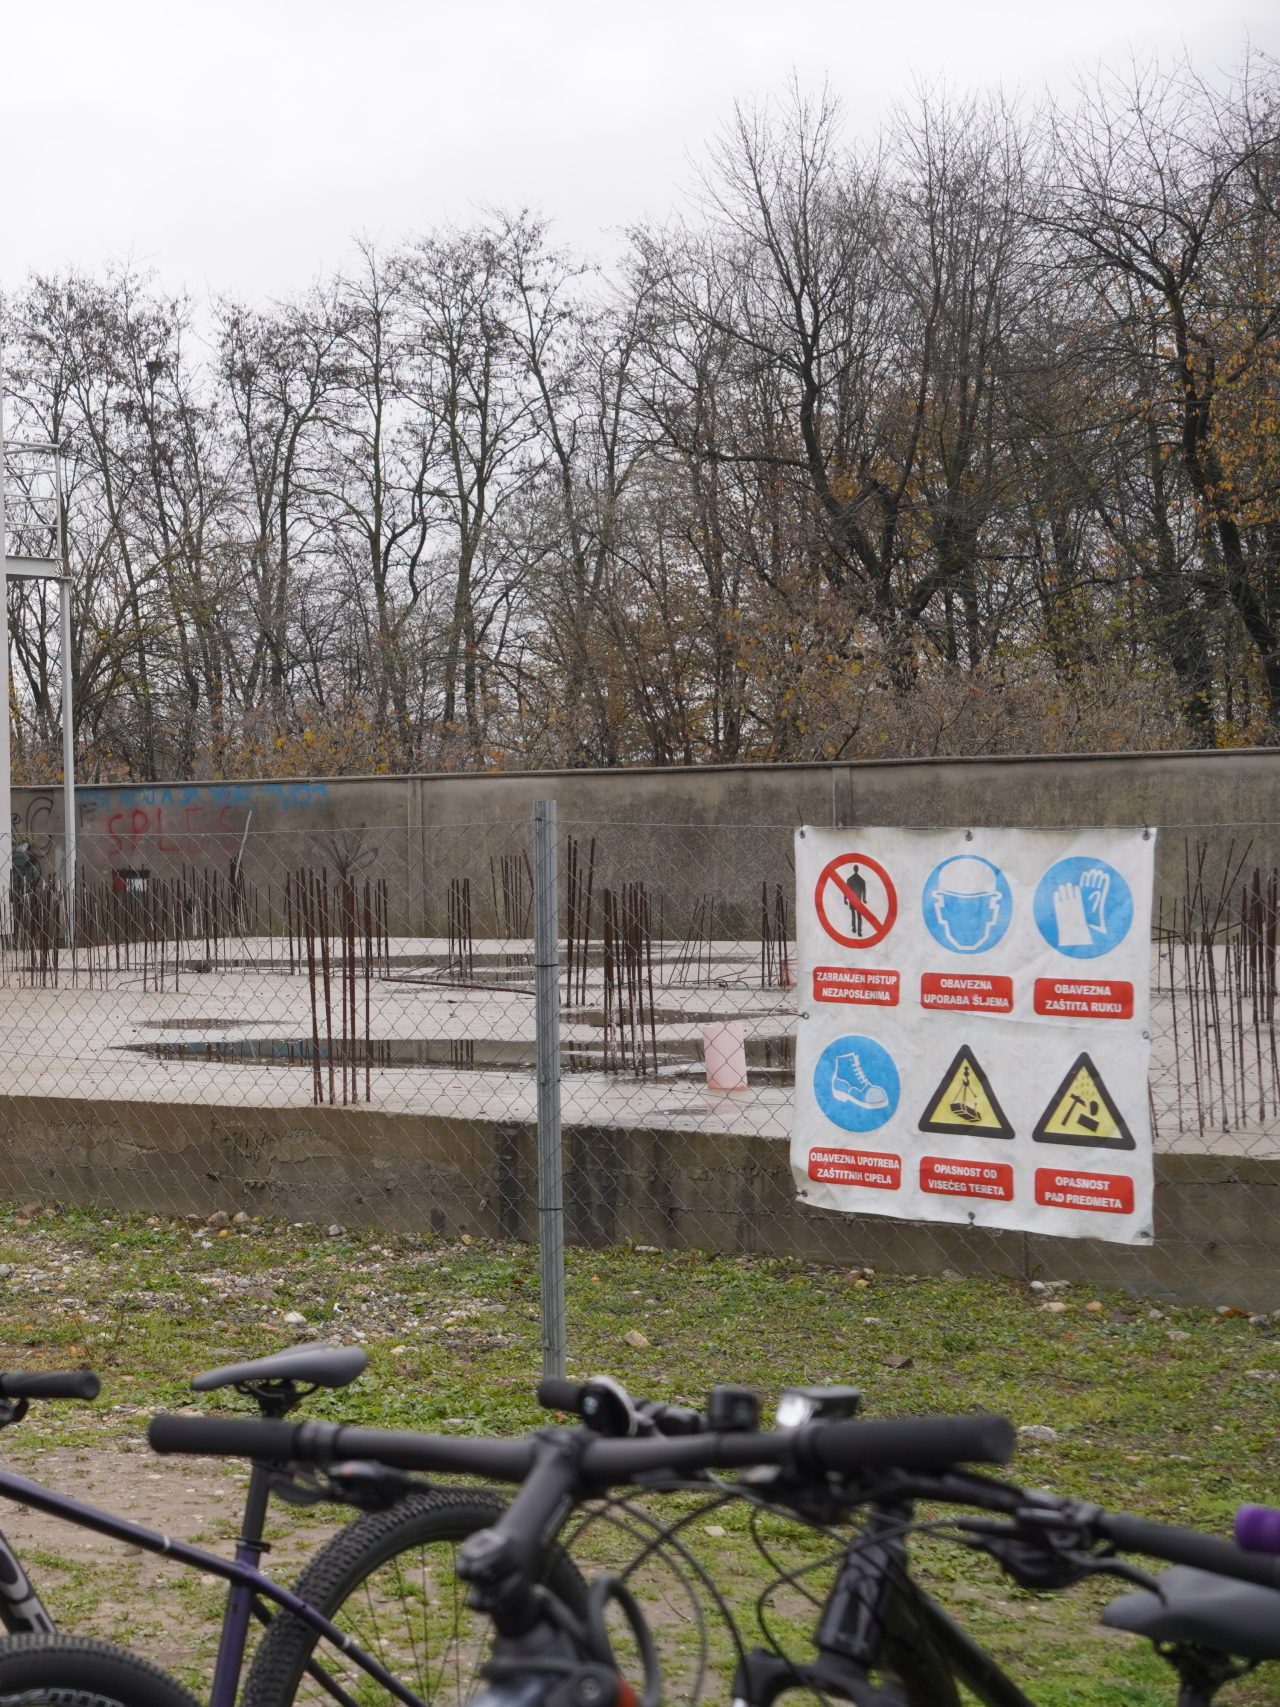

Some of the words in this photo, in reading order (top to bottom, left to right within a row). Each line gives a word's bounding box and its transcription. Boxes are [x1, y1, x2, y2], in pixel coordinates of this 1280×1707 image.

[816, 971, 866, 984] ZABRANJEN
[867, 974, 897, 985] PISTUP
[940, 978, 993, 991] OBAVEZNA
[822, 987, 891, 1001] NEZAPOSLENIMA
[1054, 984, 1112, 996] OBAVEZNA
[923, 993, 970, 1006] UPORABA
[972, 994, 1009, 1008] ŠLJEMA
[1045, 998, 1088, 1012] ZAŠTITA
[1090, 1001, 1122, 1013] RUKU
[810, 1152, 856, 1165] OBAVEZNA
[857, 1156, 900, 1169] UPOTREBA
[816, 1167, 863, 1181] ZAŠTITNIH
[864, 1174, 892, 1185] CIPELA
[933, 1163, 981, 1177] OPASNOST
[983, 1168, 998, 1179] OD
[927, 1178, 967, 1192] VISEĆEG
[969, 1183, 1005, 1196] TERETA
[1055, 1176, 1111, 1191] OPASNOST
[1044, 1191, 1064, 1203] PAD
[1066, 1193, 1123, 1209] PREDMETA
